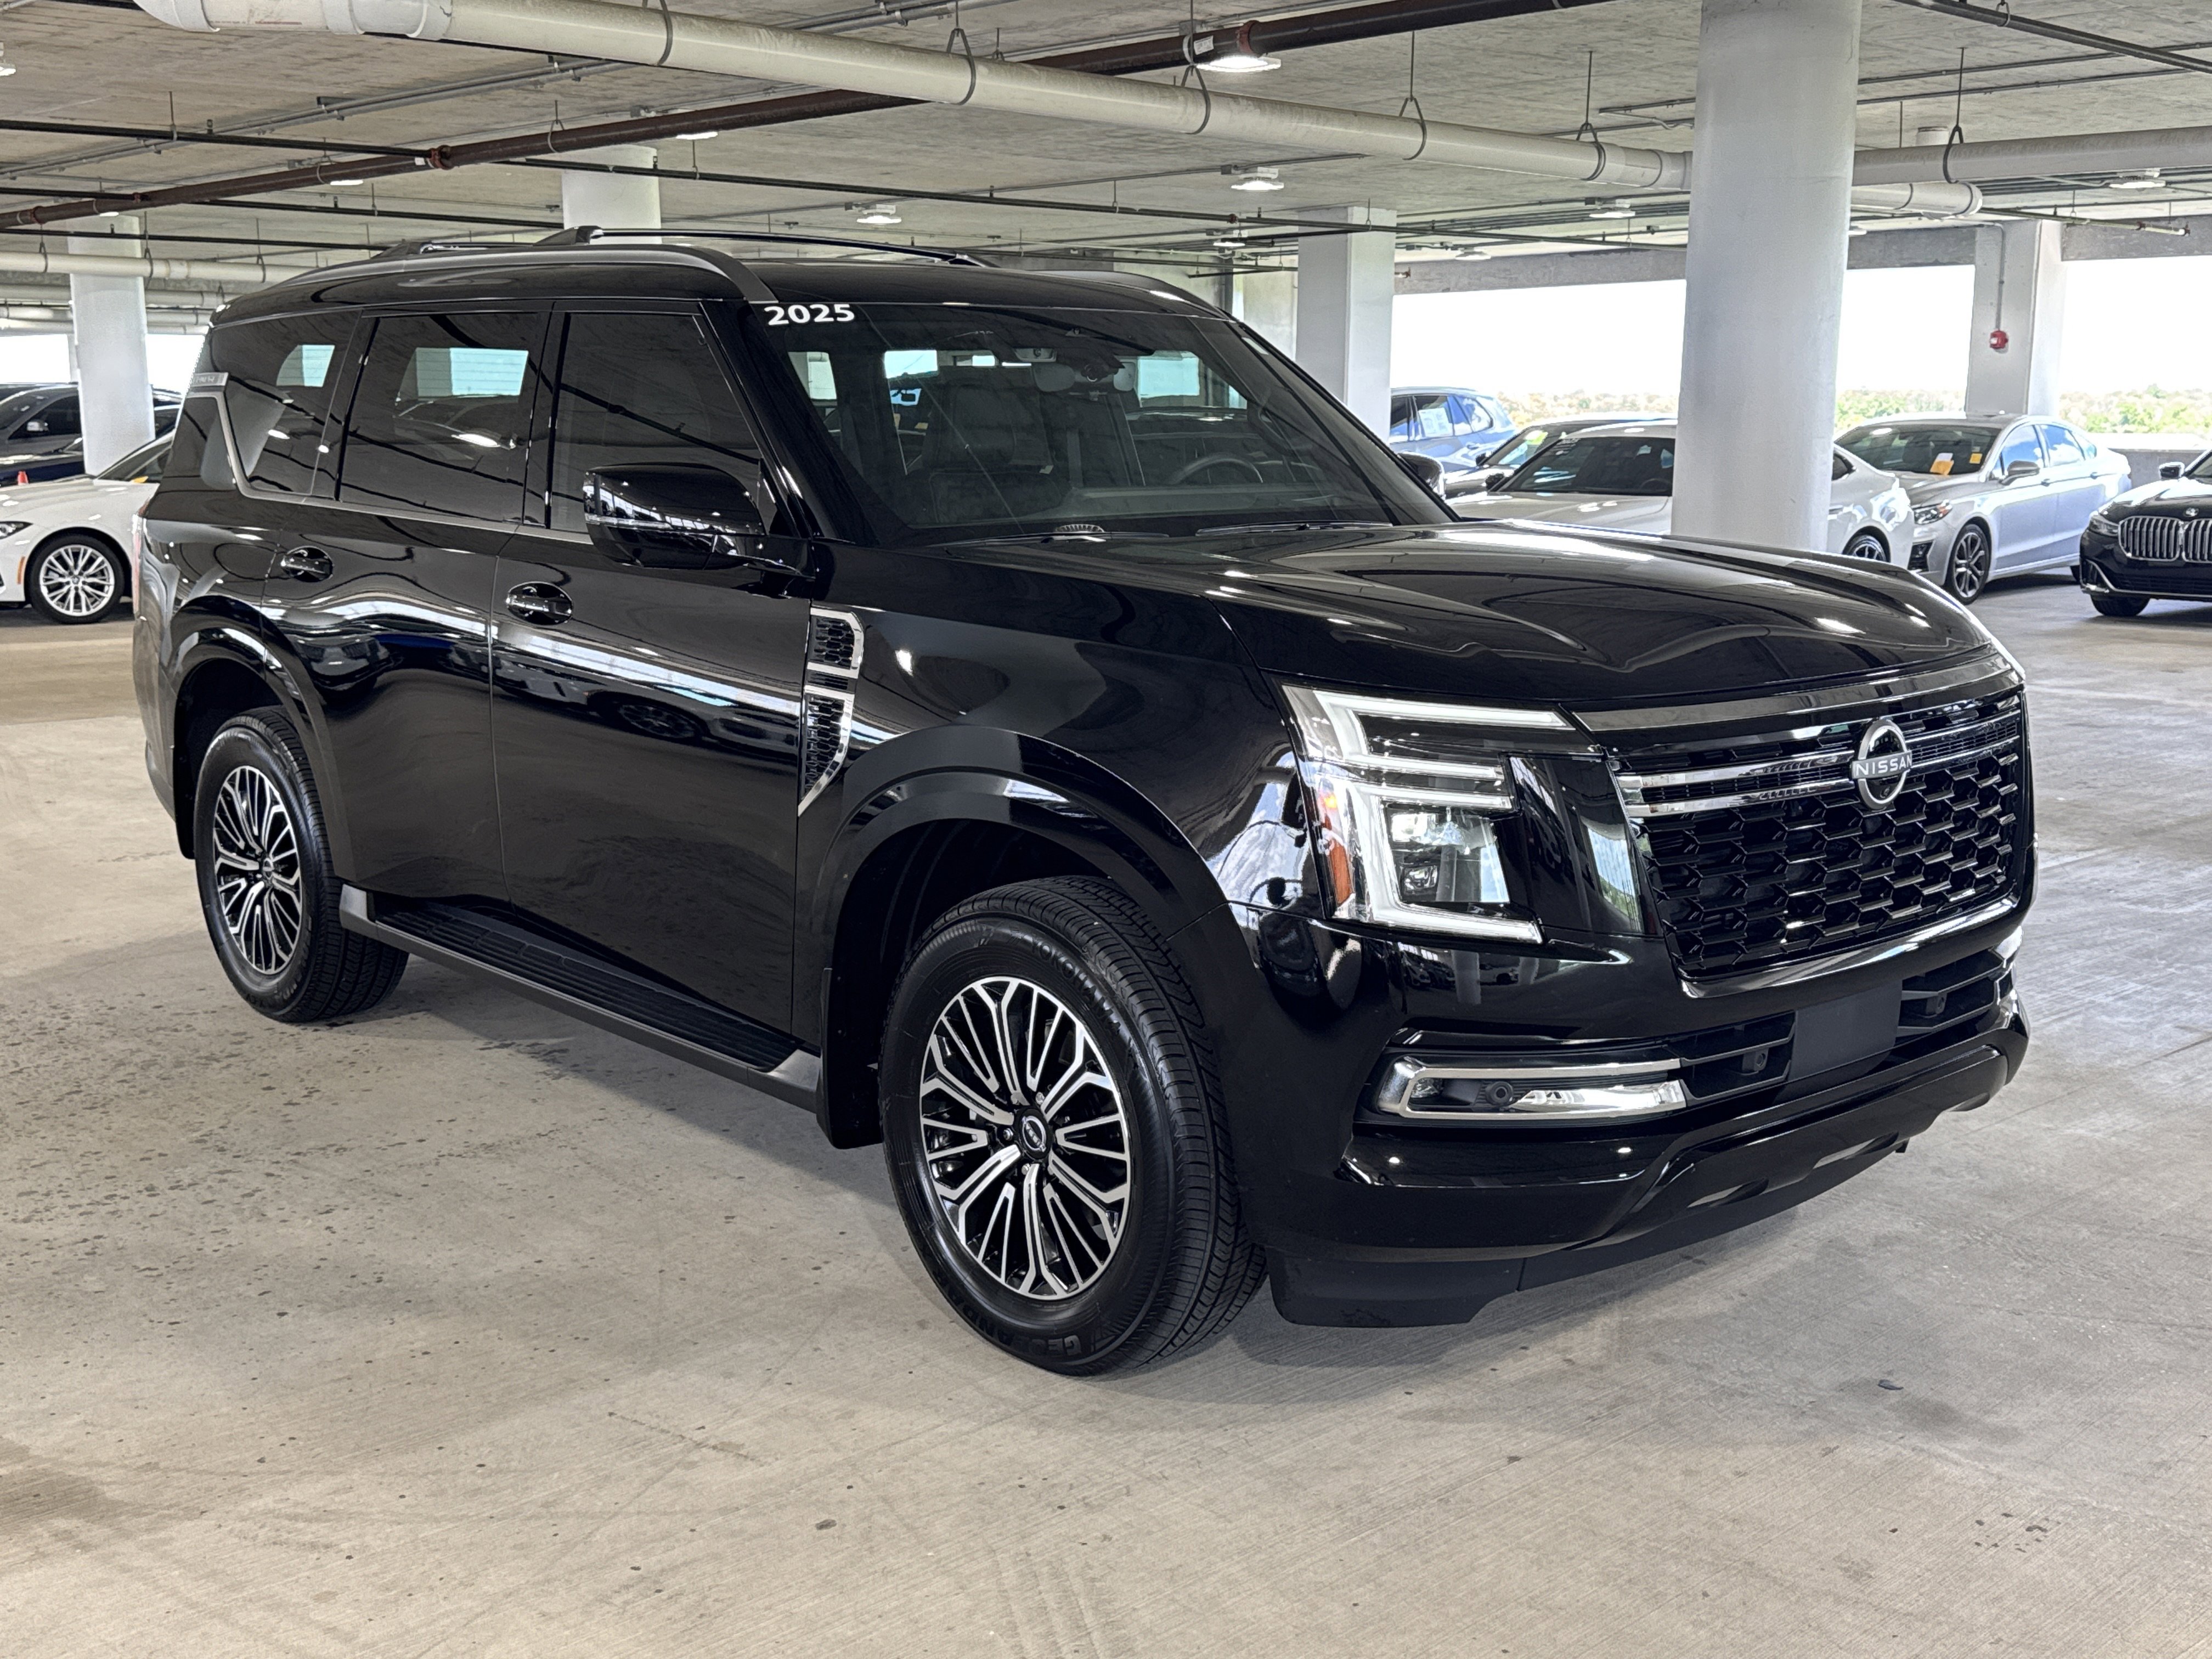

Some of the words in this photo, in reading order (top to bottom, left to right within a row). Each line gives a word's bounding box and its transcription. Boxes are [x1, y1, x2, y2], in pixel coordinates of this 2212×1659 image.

[764, 304, 855, 326] 2025
[1855, 754, 1912, 776] NISSAN
[1030, 937, 1121, 1036] YOKOHAMA
